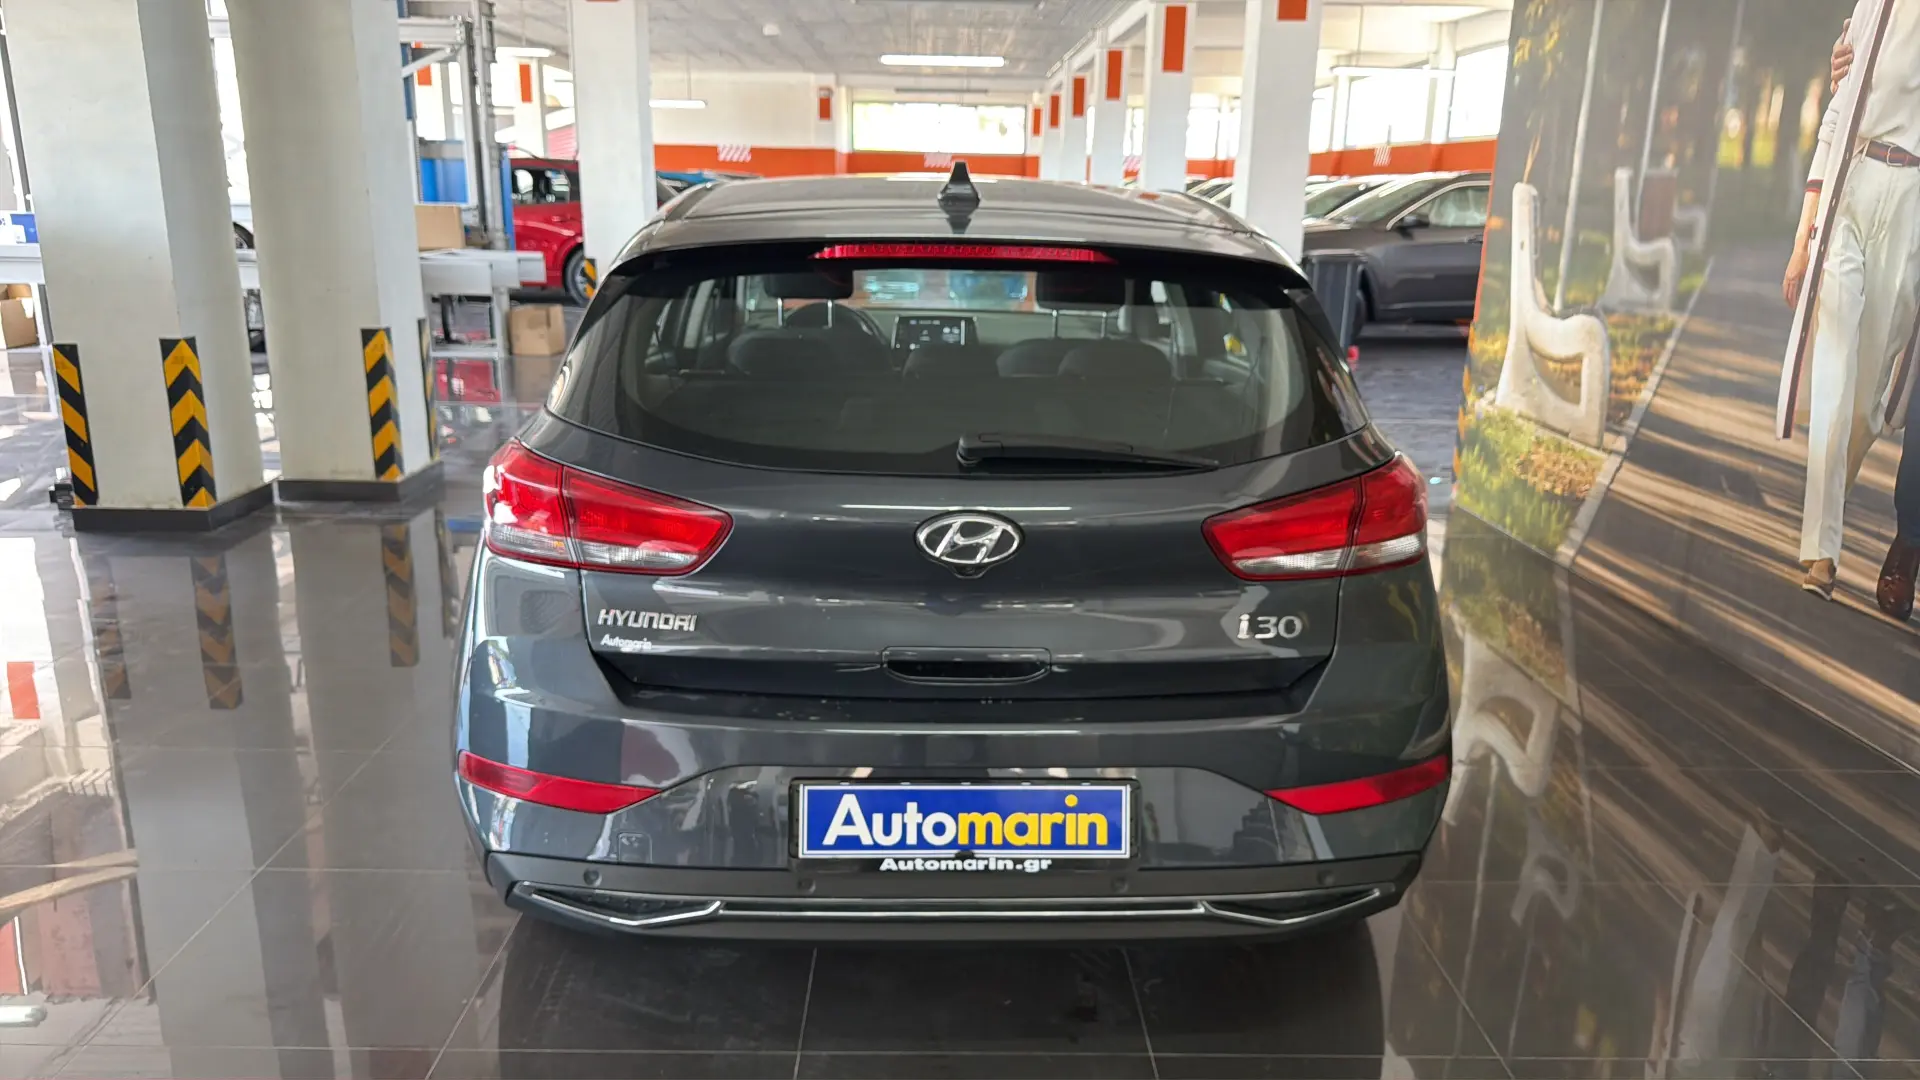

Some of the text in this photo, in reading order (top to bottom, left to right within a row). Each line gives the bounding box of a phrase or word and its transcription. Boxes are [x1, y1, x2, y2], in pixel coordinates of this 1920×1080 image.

[597, 608, 698, 632] HYUNDAI
[1236, 613, 1303, 639] i30
[822, 793, 1108, 847] Automarin
[879, 856, 1052, 873] Automarin.gr
